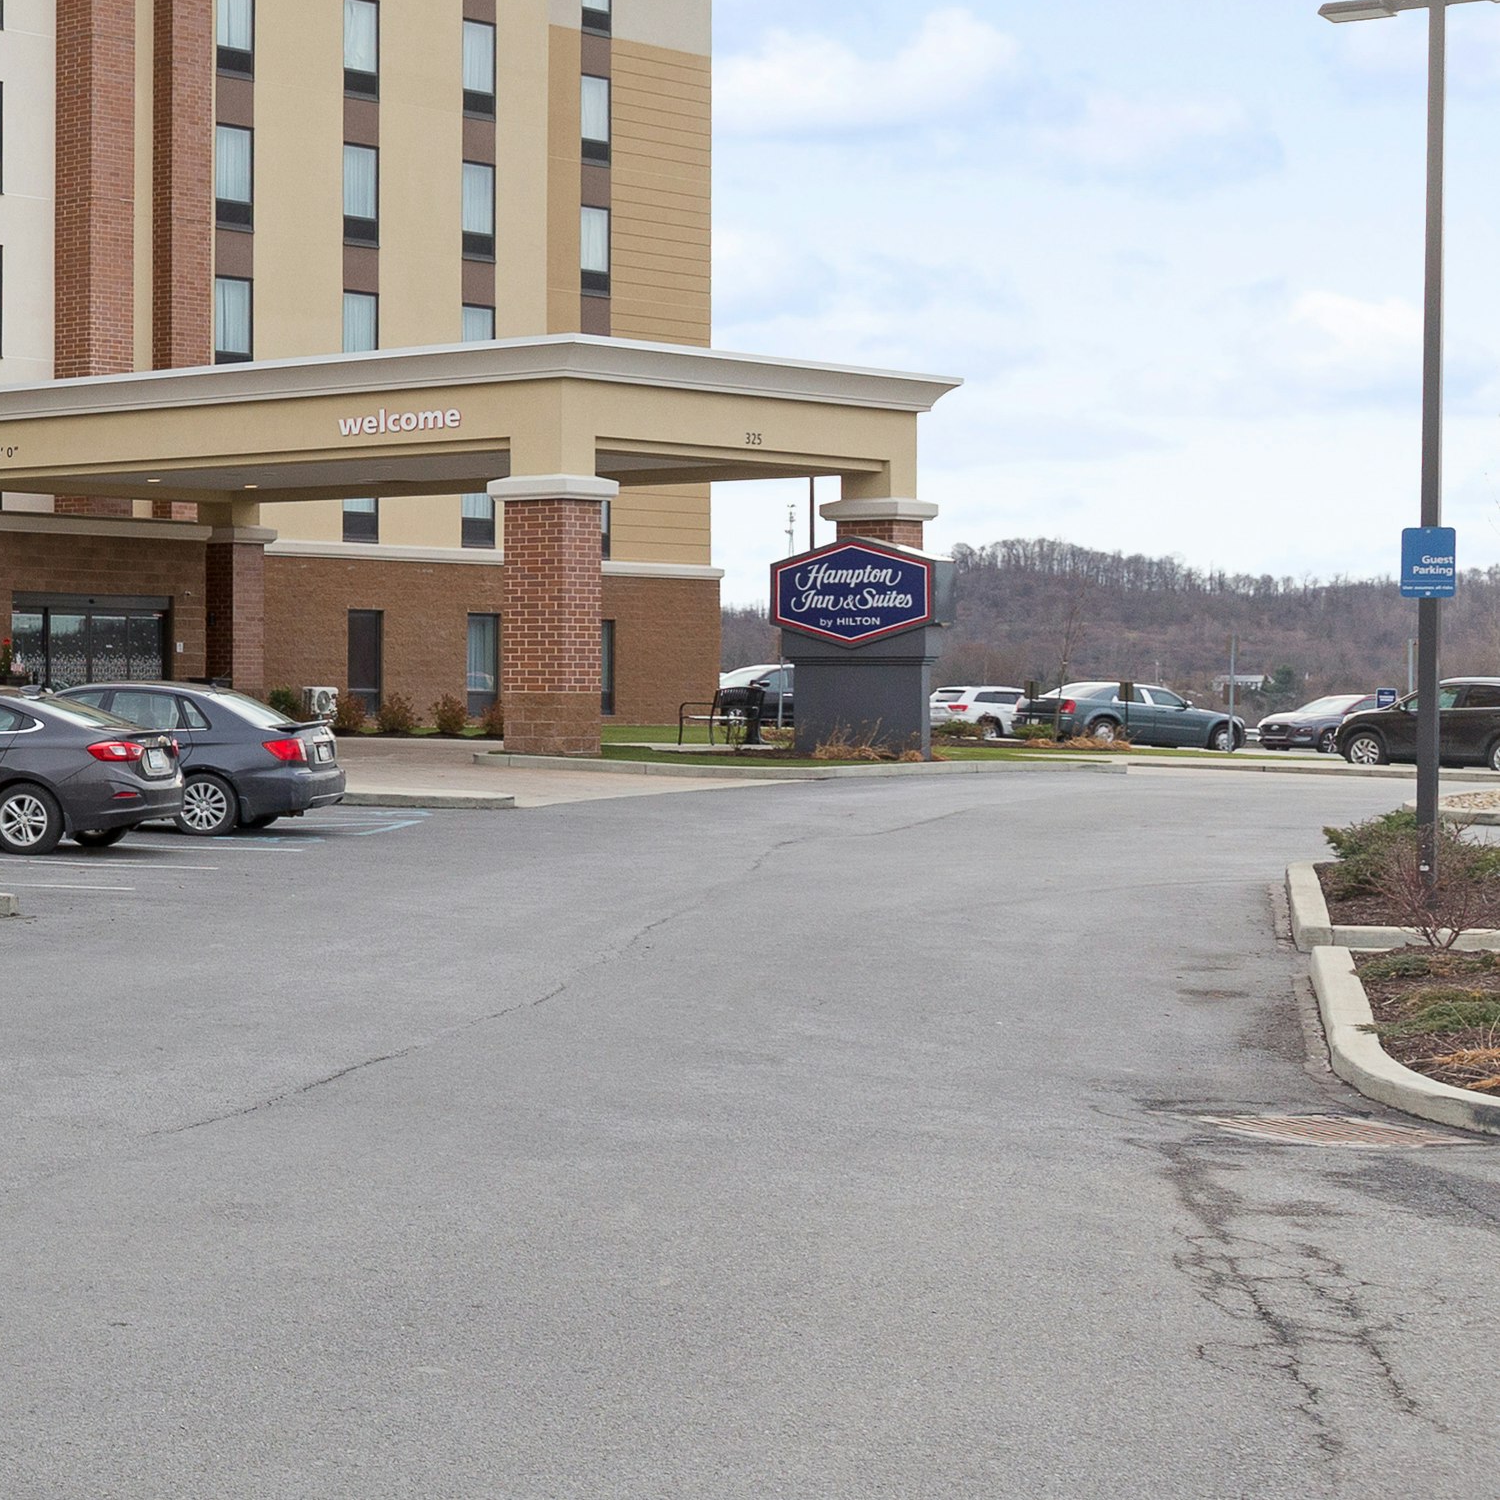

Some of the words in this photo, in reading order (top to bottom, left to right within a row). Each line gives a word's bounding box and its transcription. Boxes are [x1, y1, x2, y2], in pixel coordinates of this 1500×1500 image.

[338, 408, 461, 437] welcome
[745, 432, 762, 445] 325
[1421, 555, 1454, 564] Guest
[795, 562, 902, 591] Hampton
[1412, 565, 1454, 577] Parking
[791, 590, 844, 613] Inn
[843, 595, 858, 611] &
[855, 588, 913, 610] Suites
[819, 617, 833, 628] by
[836, 616, 881, 626] HILTON
